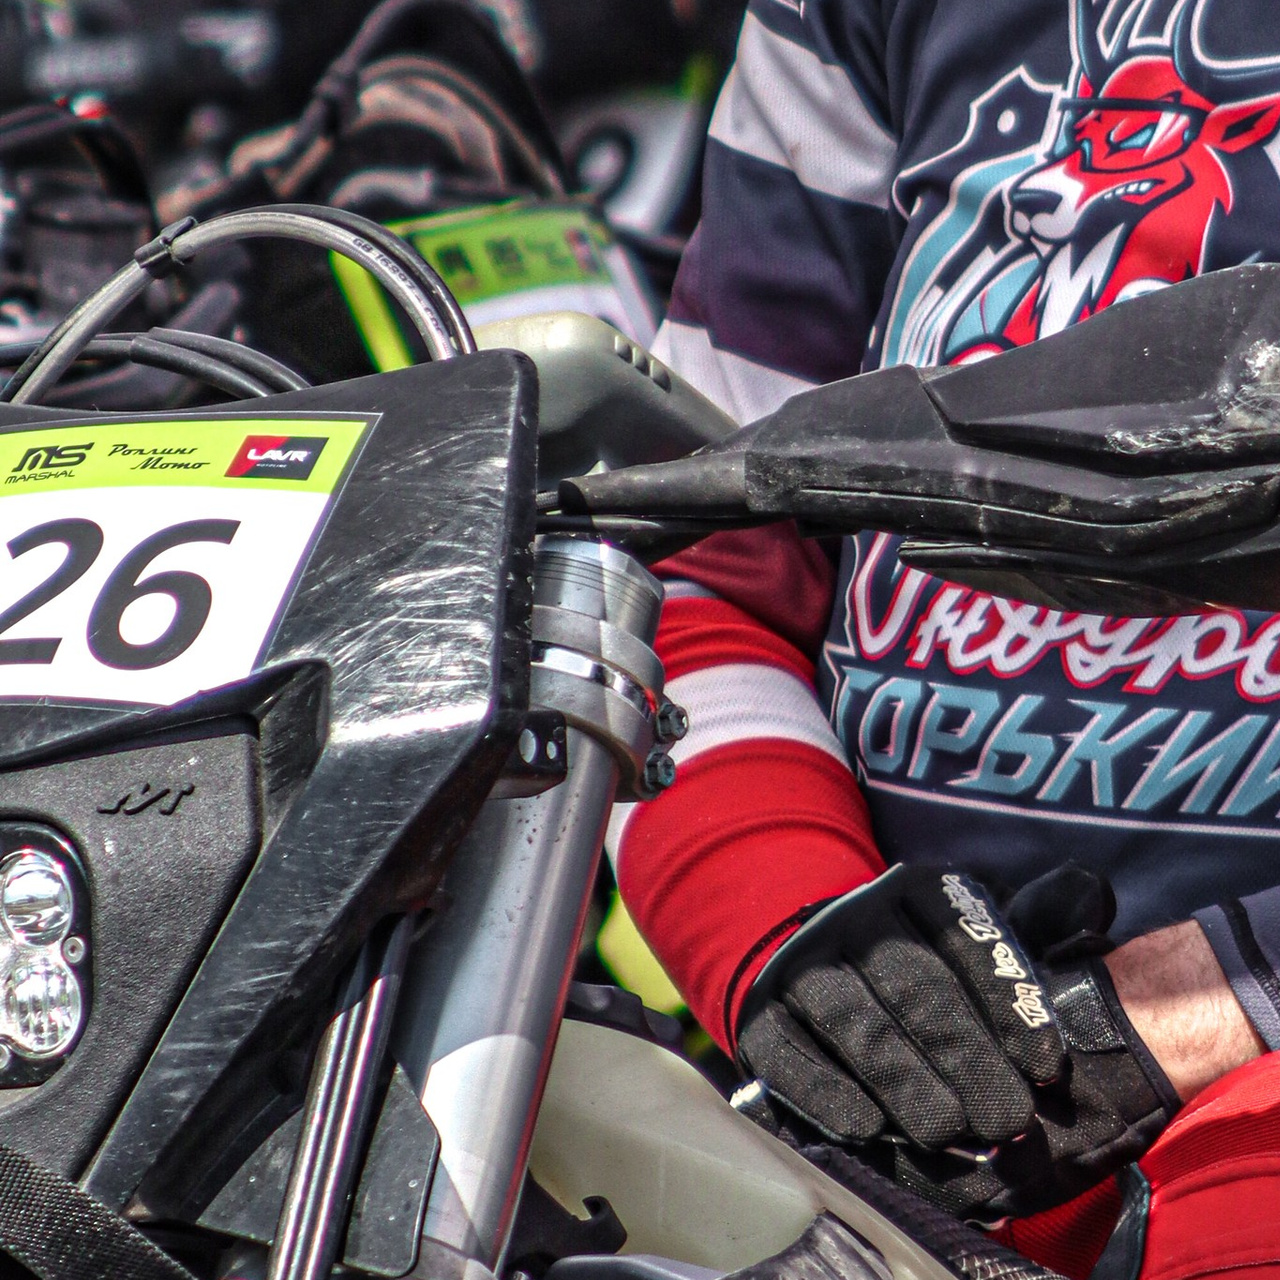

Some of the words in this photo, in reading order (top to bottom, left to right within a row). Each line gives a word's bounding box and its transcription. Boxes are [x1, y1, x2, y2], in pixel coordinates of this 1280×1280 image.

[246, 448, 309, 462] LAVR
[130, 456, 211, 471] Мото
[4, 469, 76, 485] MARSHAL
[992, 942, 1027, 980] Lee
